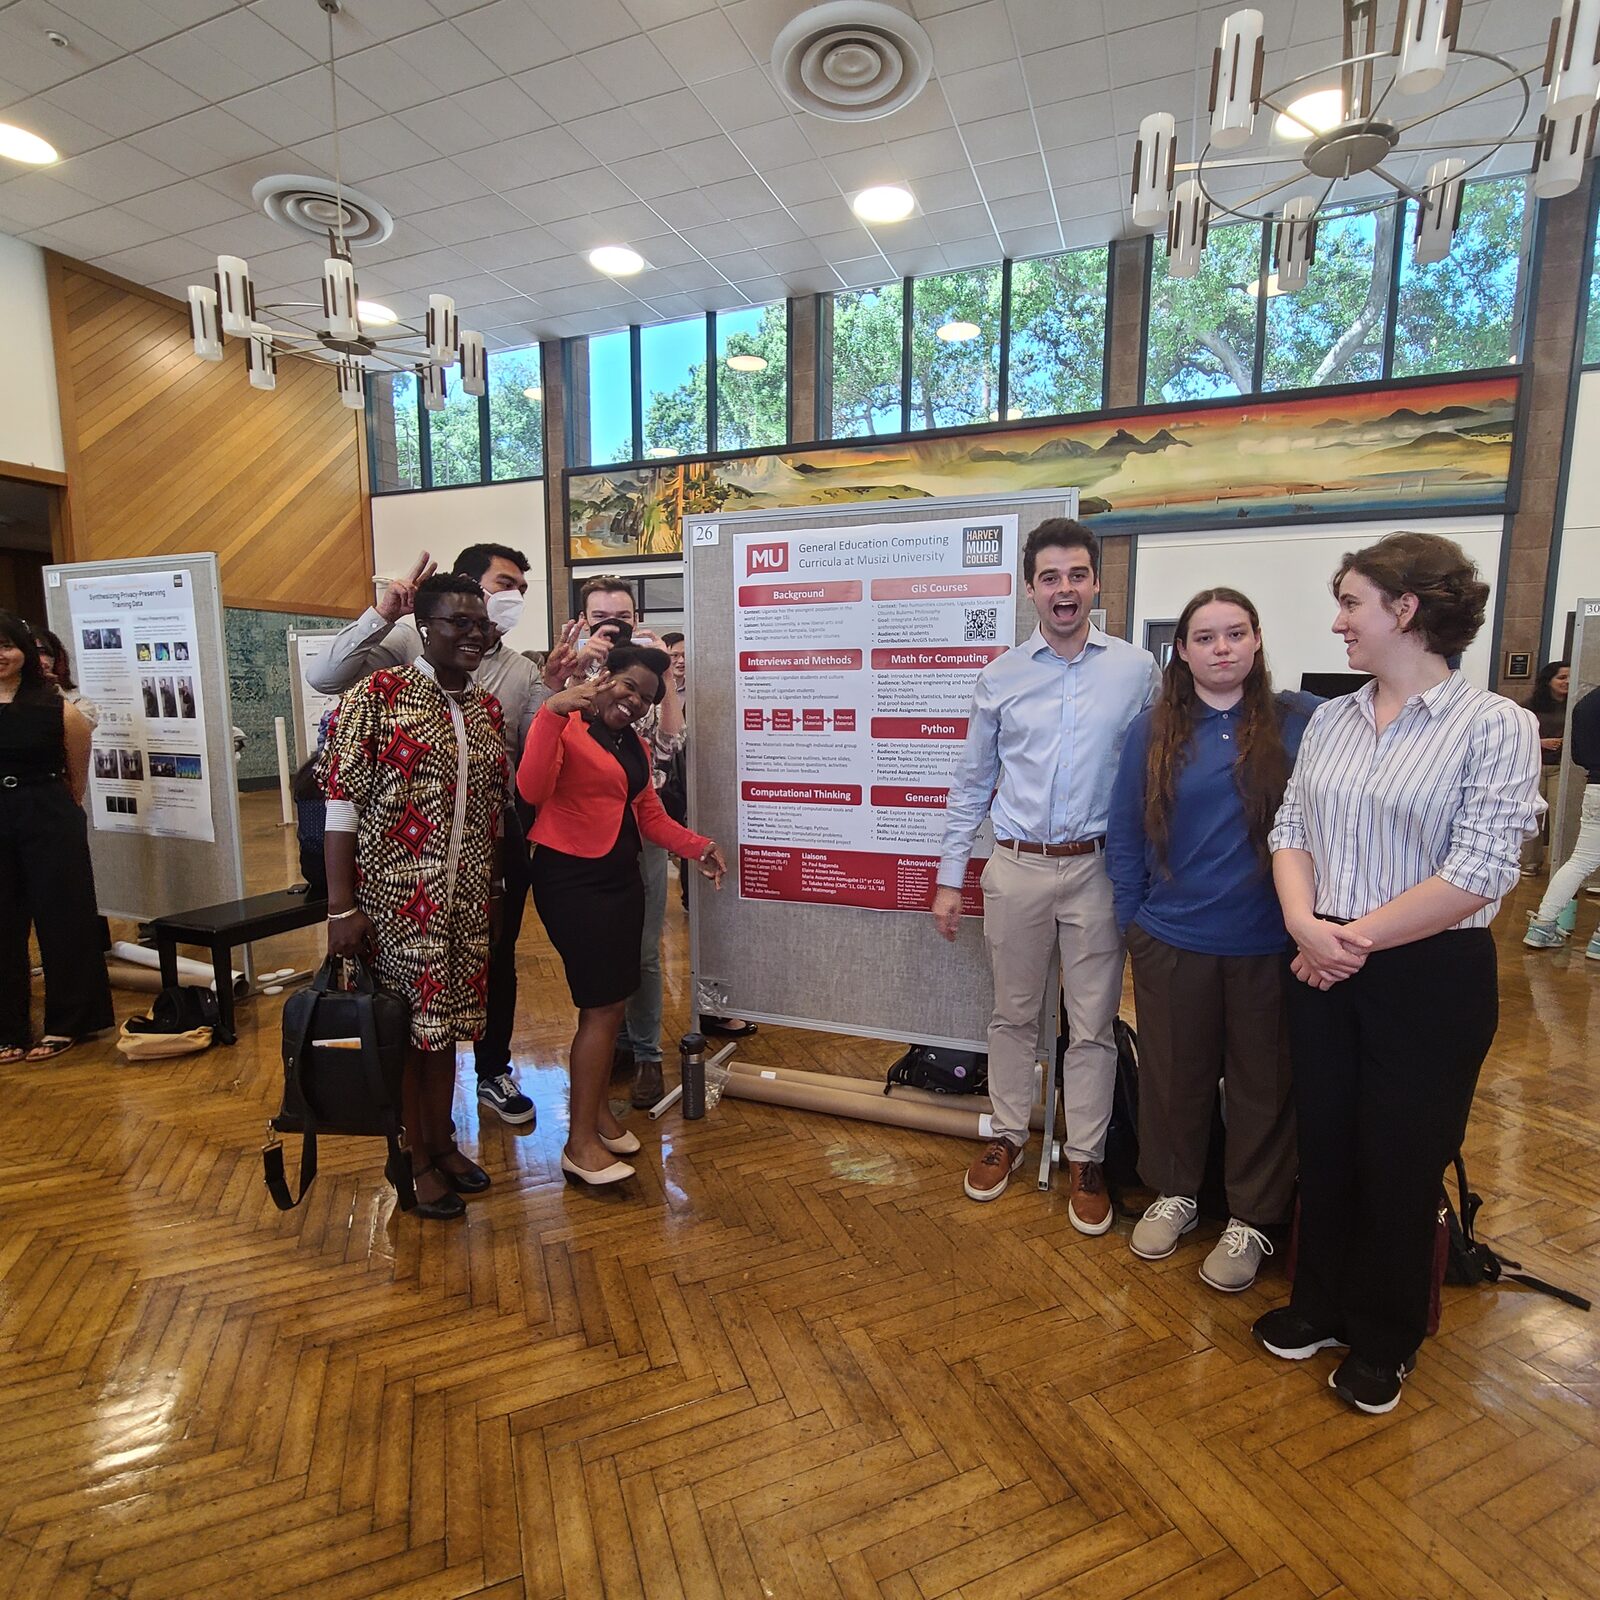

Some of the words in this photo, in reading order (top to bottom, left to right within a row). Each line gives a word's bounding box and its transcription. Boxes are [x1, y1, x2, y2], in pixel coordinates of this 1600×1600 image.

[696, 525, 712, 540] 26
[967, 529, 999, 540] HARVEY
[799, 542, 836, 553] General
[840, 539, 888, 551] Education
[892, 535, 949, 547] Computing
[967, 540, 998, 554] MUDD
[752, 549, 783, 568] MU
[799, 558, 842, 568] Curricula
[845, 557, 853, 565] at
[858, 555, 889, 564] Musizi
[893, 552, 944, 563] University
[967, 554, 998, 564] COLLEGE
[912, 584, 927, 593] GIS
[930, 583, 968, 592] Courses
[90, 593, 120, 601] Synthesizing
[121, 590, 165, 599] Privacy-Preserving
[774, 589, 824, 600] Background
[1587, 605, 1600, 613] 30
[748, 658, 791, 666] Interviews
[794, 656, 809, 665] and
[812, 656, 852, 665] Methods
[892, 654, 917, 664] Math
[919, 654, 933, 663] for
[935, 653, 988, 664] Computing
[921, 725, 954, 735] Python
[751, 788, 812, 798] Computational
[814, 790, 851, 800] Thinking
[761, 850, 790, 858] Members
[898, 859, 940, 868] Acknowledg
